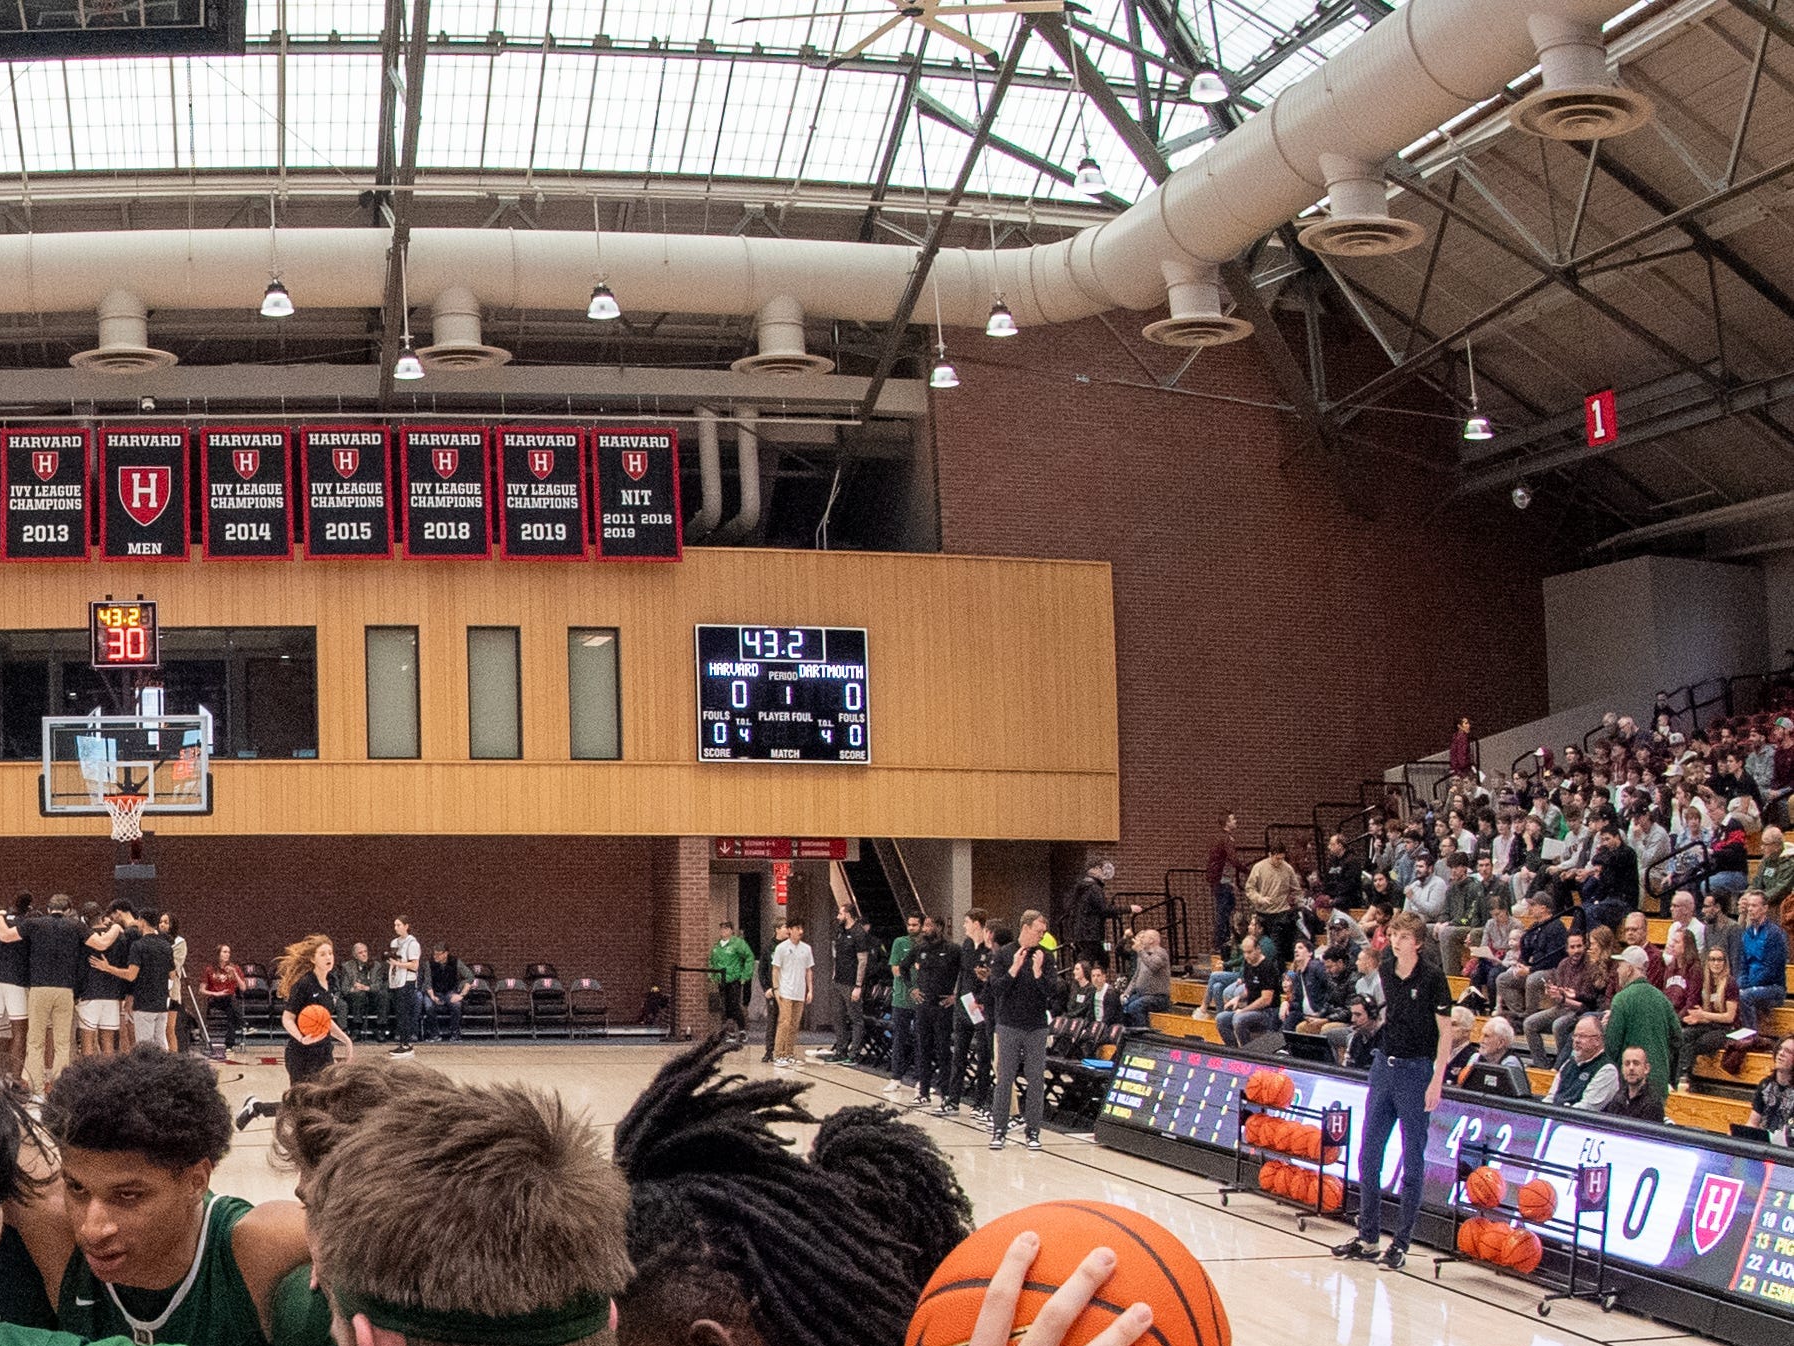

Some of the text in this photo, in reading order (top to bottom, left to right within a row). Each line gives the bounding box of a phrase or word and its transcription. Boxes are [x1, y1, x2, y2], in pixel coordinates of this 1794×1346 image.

[1592, 399, 1605, 439] 1
[10, 436, 81, 448] HARVARD
[108, 435, 180, 446] HARVARD
[210, 435, 282, 446] HARVARD
[309, 434, 381, 445] HARVARD
[409, 434, 480, 445] HARVARD
[505, 435, 575, 446] HARVARD
[600, 436, 668, 448] HARVARD
[39, 455, 52, 472] H
[240, 453, 253, 471] H
[340, 452, 352, 469] H
[439, 453, 452, 470] H
[535, 454, 547, 471] H
[629, 455, 641, 472] H
[11, 485, 81, 500] IVY LEAGUE
[132, 473, 157, 507] H
[212, 484, 282, 498] IVY LEAGUE
[312, 483, 382, 497] IVY LEAGUE
[411, 483, 481, 497] IVY LEAGUE
[508, 484, 576, 498] IVY LEAGUE
[621, 490, 651, 505] NIT
[10, 496, 81, 510] CHAMPIONS
[211, 494, 283, 508] CHAMPIONS
[311, 496, 383, 507] CHAMPIONS
[411, 496, 482, 507] CHAMPIONS
[507, 497, 578, 508] CHAMPIONS
[604, 514, 672, 524] 2011 2018
[23, 525, 68, 542] 2013
[226, 523, 271, 540] 2014
[326, 523, 371, 540] 2015
[424, 522, 469, 539] 2018
[521, 524, 566, 540] 2019
[604, 528, 635, 538] 2019
[128, 543, 161, 554] MEN
[98, 608, 140, 626] 43.2
[108, 628, 145, 659] 30
[744, 630, 803, 658] 43.2
[709, 662, 864, 681] HARVARD PERIOD DARTMOUTH
[731, 681, 861, 710] 0 1 0
[703, 711, 865, 723] FOULS PLAYER FOUL FOULS
[714, 723, 862, 746] 0 4 4 0
[703, 748, 866, 760] SCORE MATCH SCORE
[1332, 1115, 1343, 1133] H
[1579, 1137, 1605, 1164] FLS
[1589, 1172, 1601, 1193] H
[1622, 1167, 1659, 1240] 0
[1773, 1191, 1785, 1207] 2
[1746, 1253, 1763, 1271] 22
